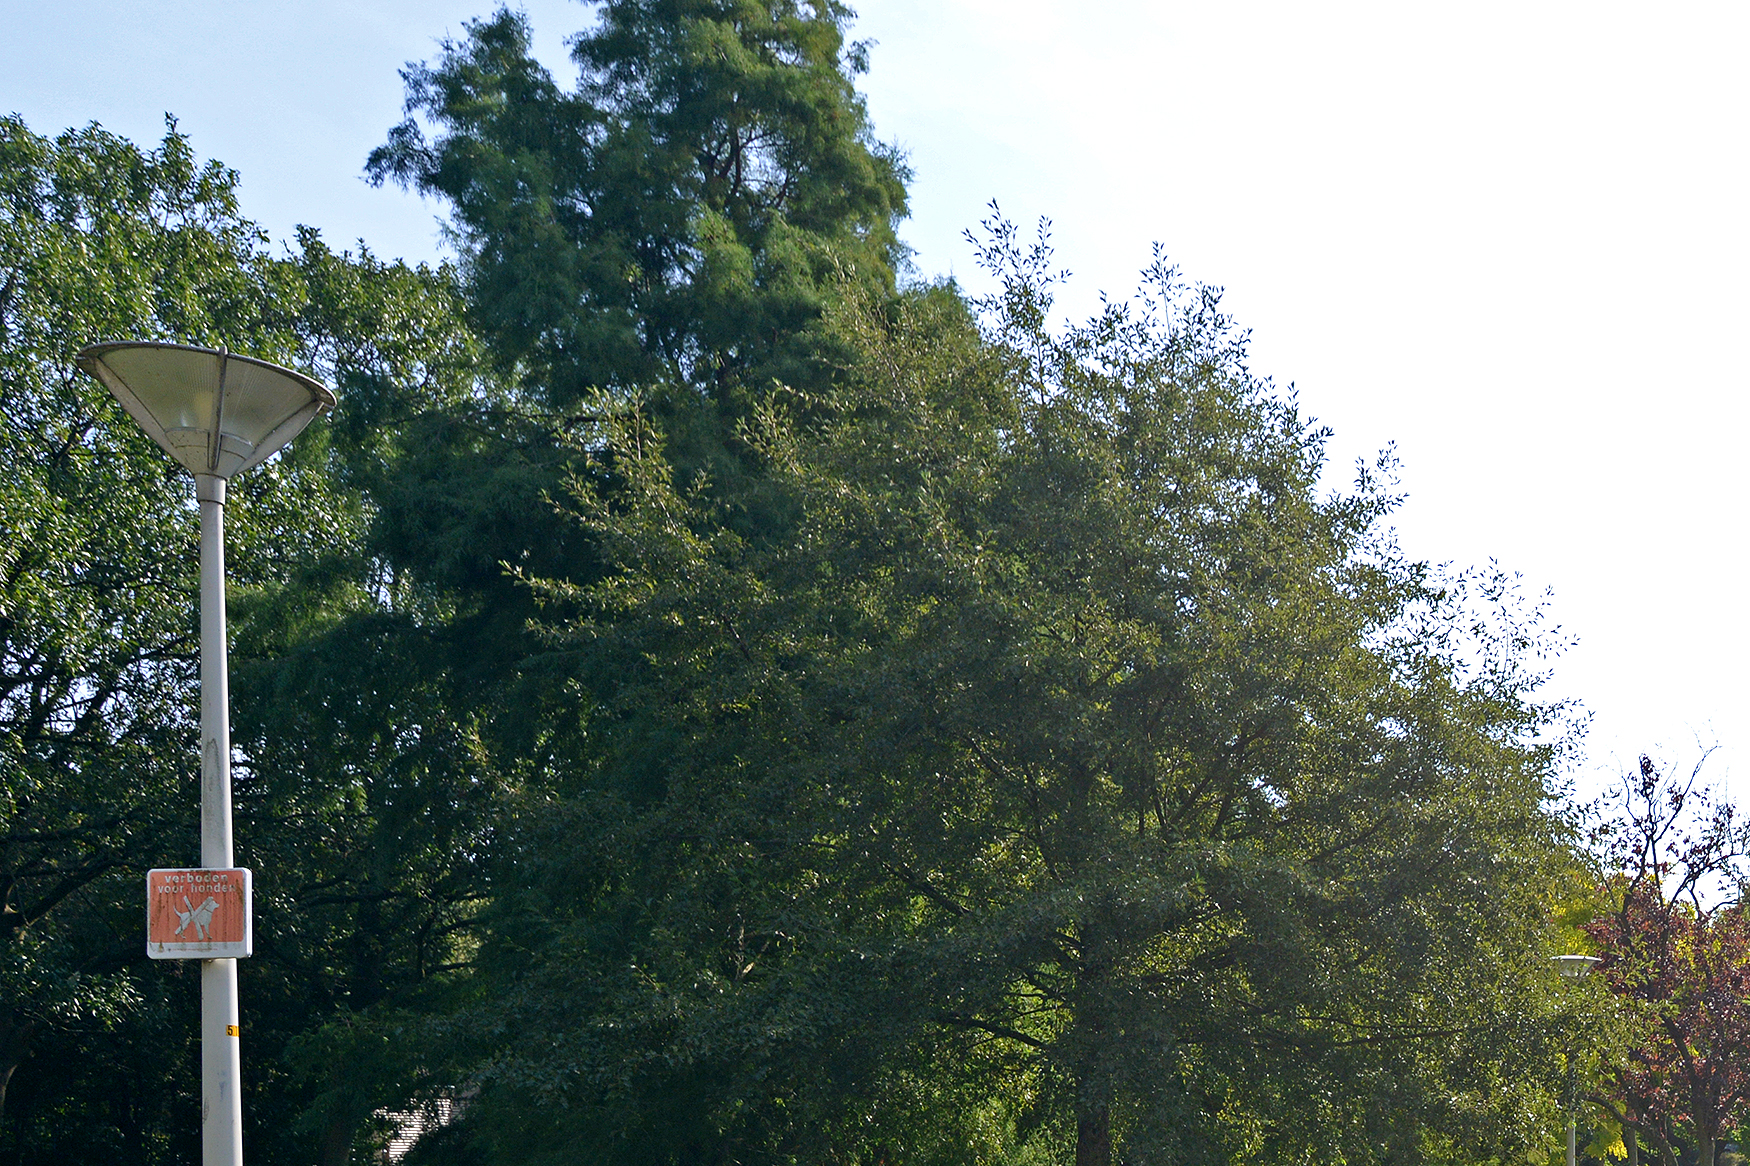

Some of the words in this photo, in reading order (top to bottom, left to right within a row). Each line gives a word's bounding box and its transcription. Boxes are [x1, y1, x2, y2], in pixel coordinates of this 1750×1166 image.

[164, 873, 228, 883] verboden
[158, 885, 184, 894] voor
[191, 883, 236, 893] honden
